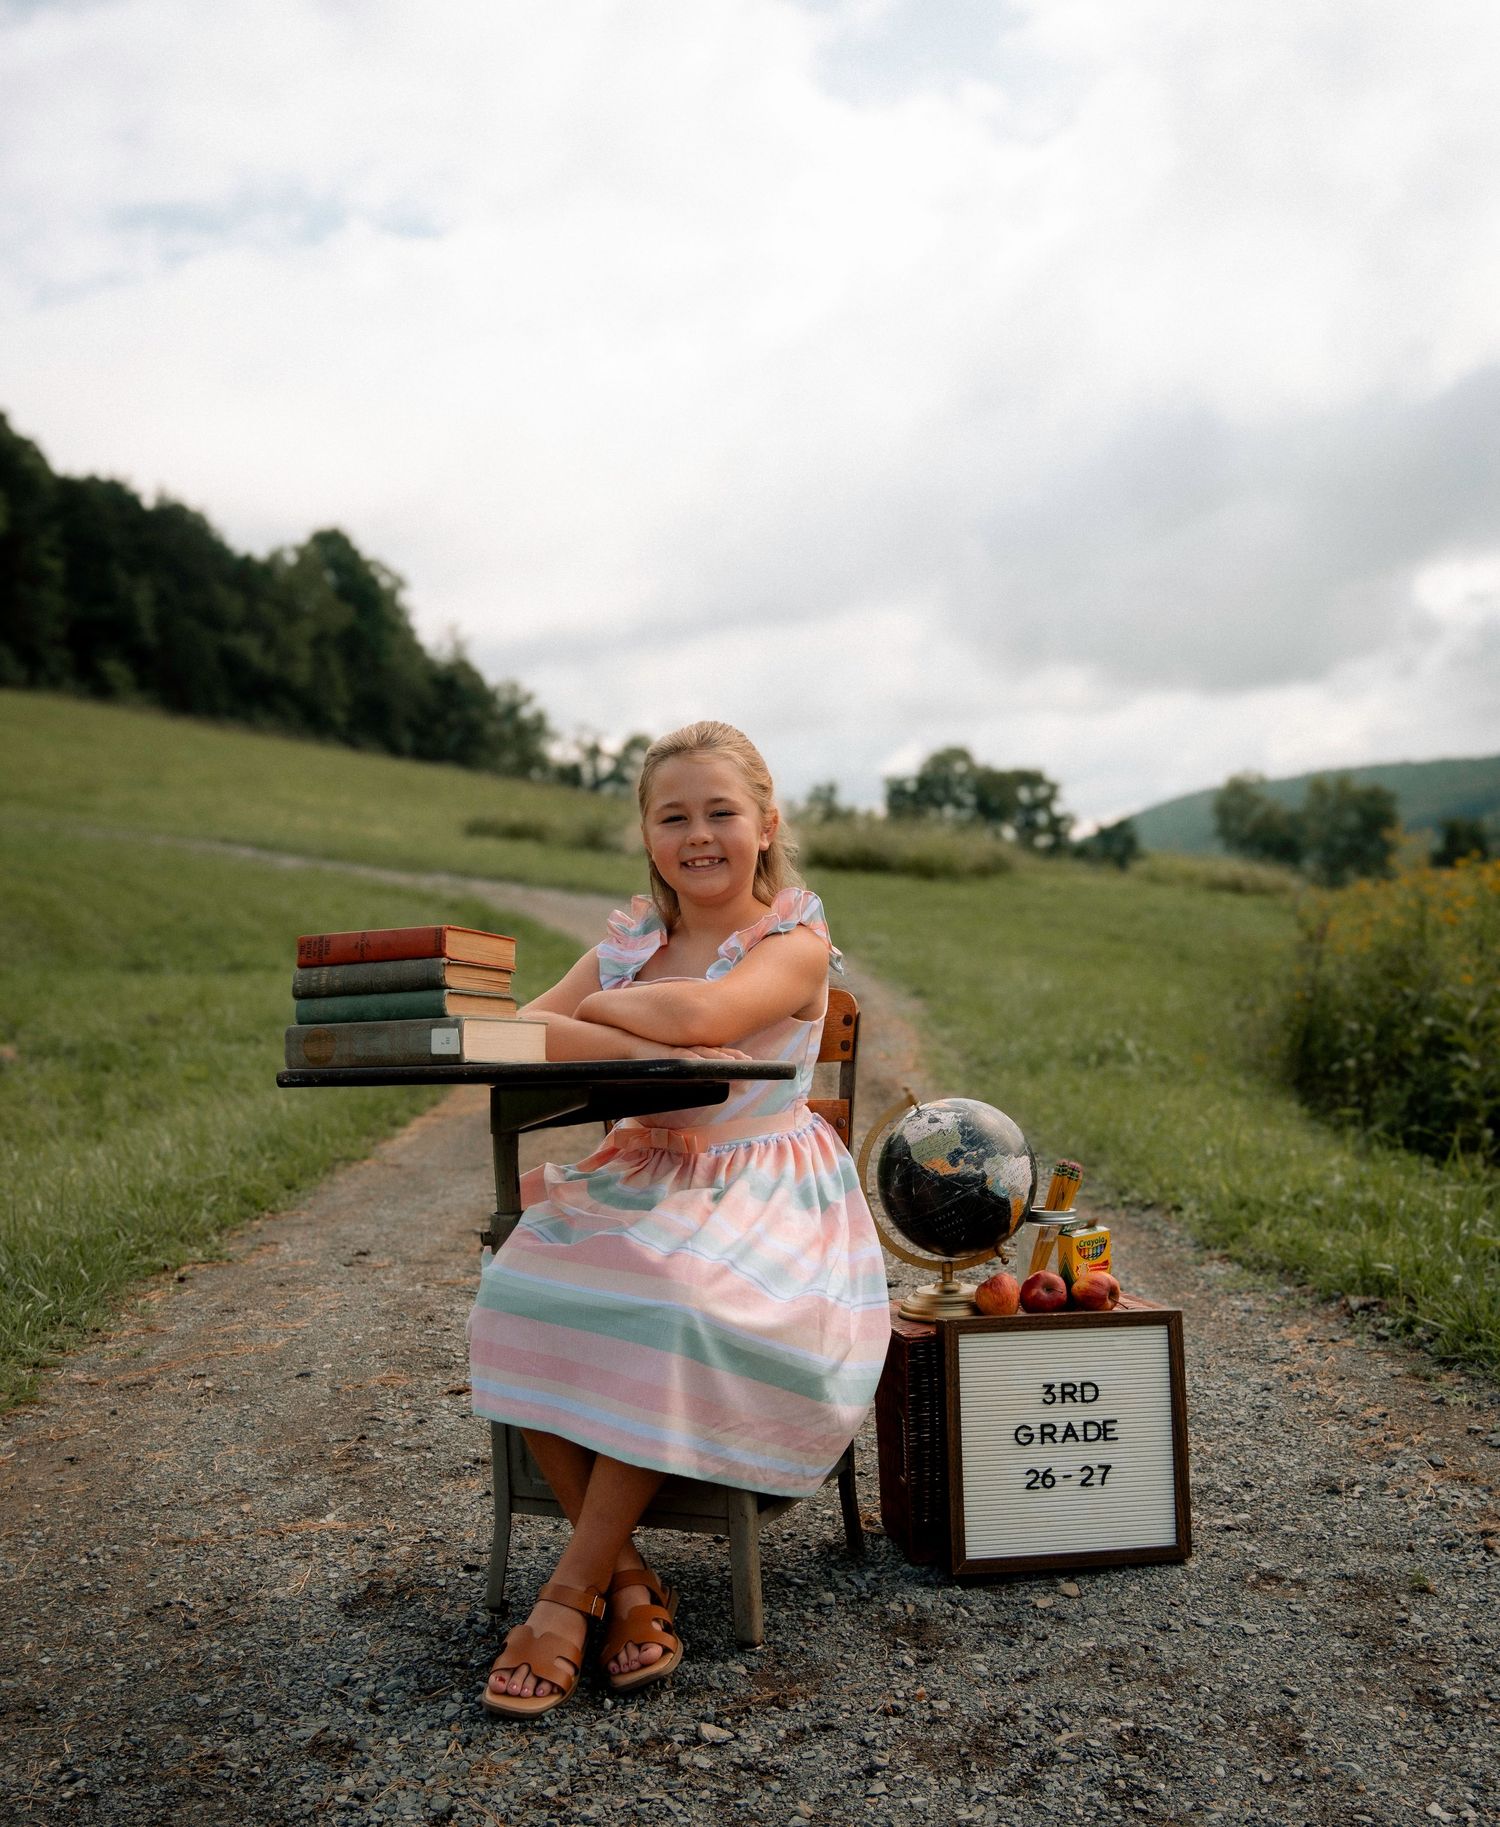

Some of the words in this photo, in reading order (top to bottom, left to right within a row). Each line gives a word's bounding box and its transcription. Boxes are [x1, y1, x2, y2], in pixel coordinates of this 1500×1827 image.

[1078, 1236, 1106, 1248] Crayola
[1041, 1381, 1100, 1405] 3RD
[1014, 1419, 1119, 1446] GRADE
[1025, 1464, 1112, 1490] 26-27
